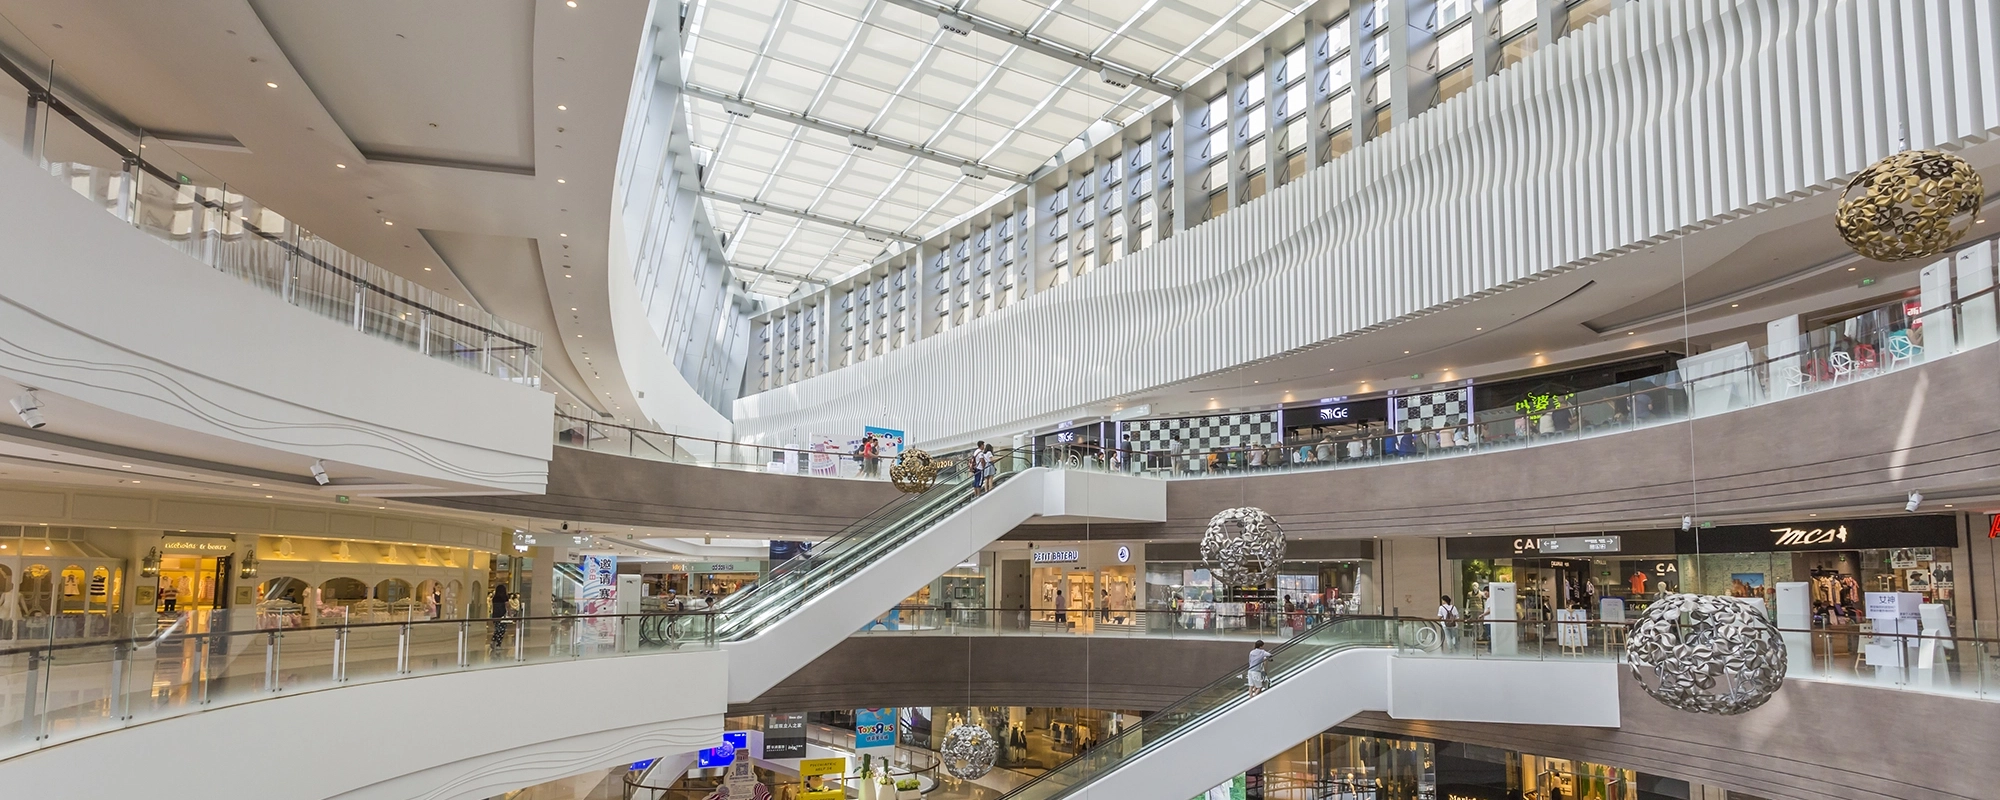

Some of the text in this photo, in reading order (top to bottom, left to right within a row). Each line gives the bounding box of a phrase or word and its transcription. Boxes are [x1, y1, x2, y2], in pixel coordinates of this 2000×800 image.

[1769, 527, 1836, 545] mcs
[1034, 550, 1079, 561] PETIT BATEAU
[600, 558, 612, 599] 邀请赛
